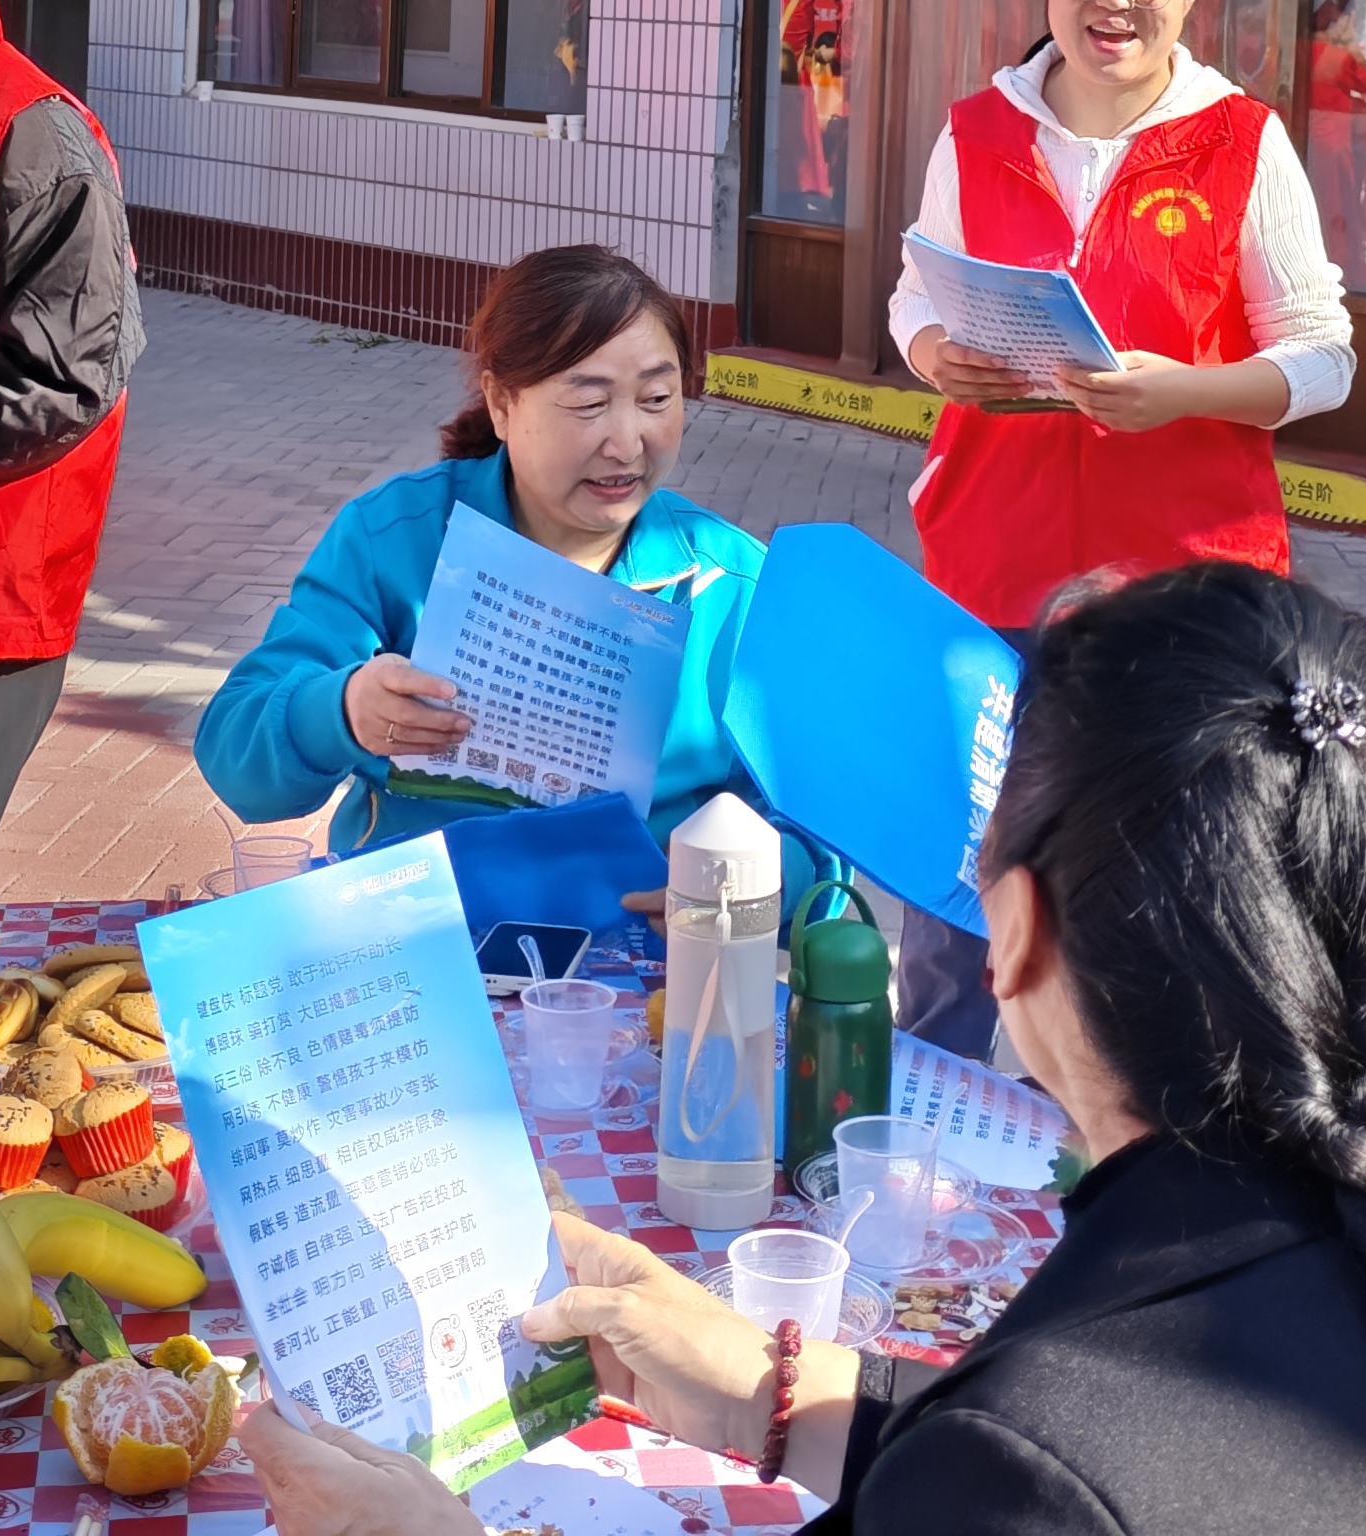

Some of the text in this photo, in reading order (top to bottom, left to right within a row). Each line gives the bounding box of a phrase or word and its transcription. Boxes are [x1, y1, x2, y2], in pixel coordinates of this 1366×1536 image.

[712, 367, 874, 413] 小心台阶 小心台阶
[239, 975, 285, 1004] 标题党
[288, 936, 402, 988] 敢于批评不助长
[298, 970, 412, 1023] 大胆揭露正导向
[214, 1003, 421, 1094] 反三俗 除不良 色情赌毒须提防
[223, 1038, 430, 1130] 网引诱 不健康 警惕孩子来模仿
[276, 1117, 322, 1148] 莫炒作
[327, 1073, 439, 1128] 灾害事故少夸张
[241, 1108, 449, 1206] 网热点 细思量 相信权威辨假象
[249, 1143, 458, 1243] 假账号 造流量 恶意营销必曝光
[258, 1178, 468, 1281] 守诚信 自律强 违法广告拒投放
[266, 1213, 478, 1322] 全社会 明方向 举报监督来护航
[273, 1248, 487, 1360] 爱河北 正能量 网络家园更清朗
